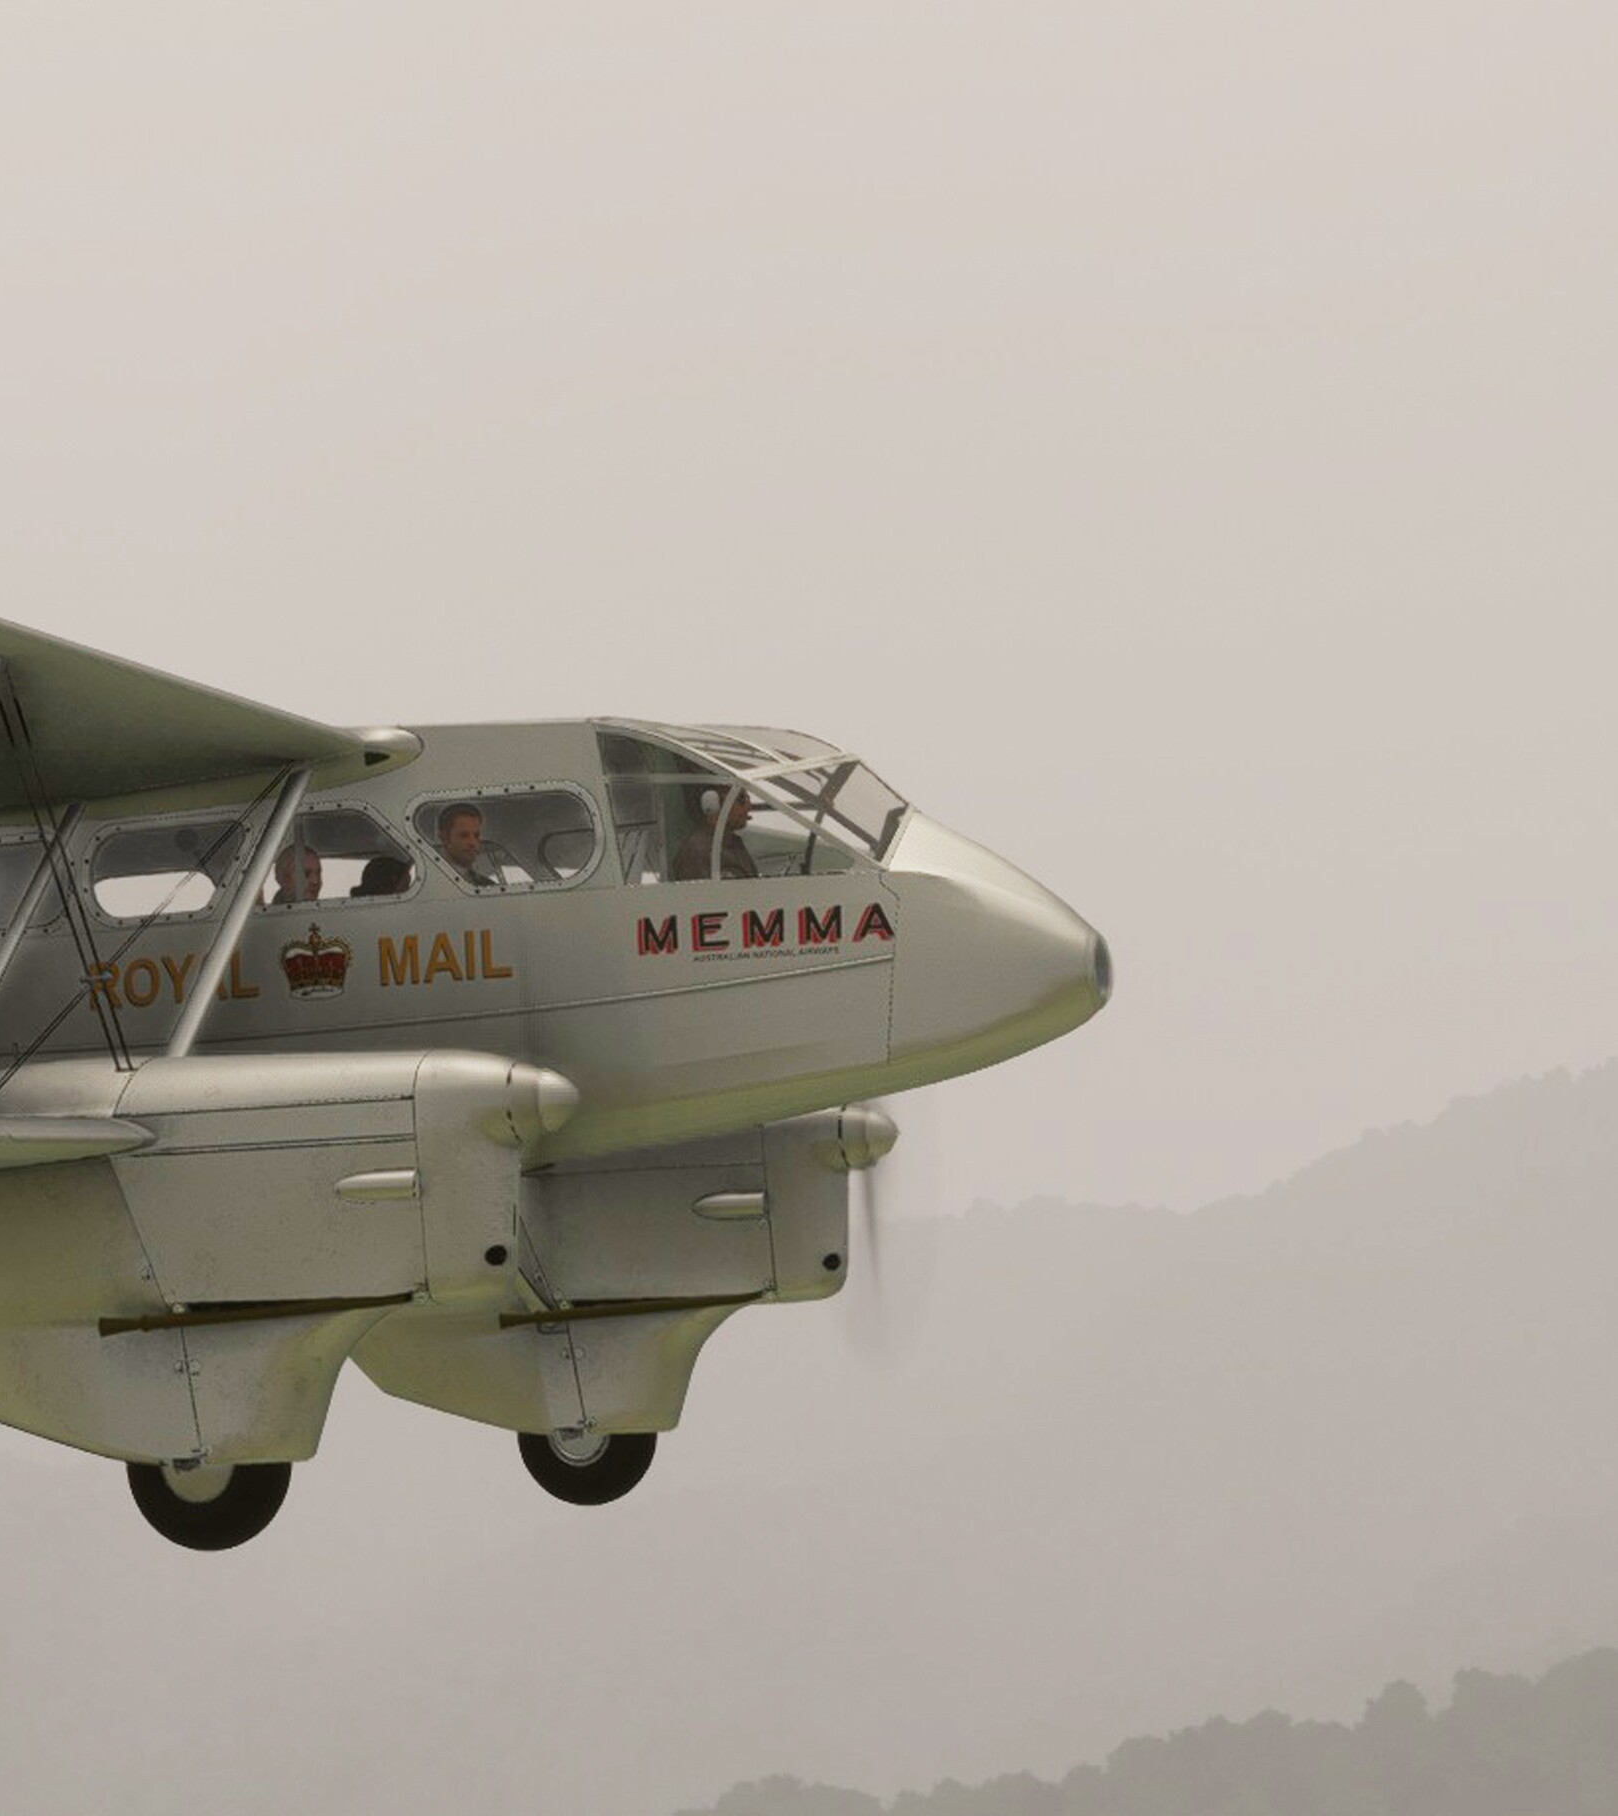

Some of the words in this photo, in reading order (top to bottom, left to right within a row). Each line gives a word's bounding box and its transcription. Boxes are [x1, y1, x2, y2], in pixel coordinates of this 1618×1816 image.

[637, 902, 895, 955] MEMMA
[89, 948, 260, 1011] ROYL
[378, 929, 514, 986] MAIL
[693, 951, 751, 963] AUSTRALIAN
[753, 948, 796, 960] NATIONAL
